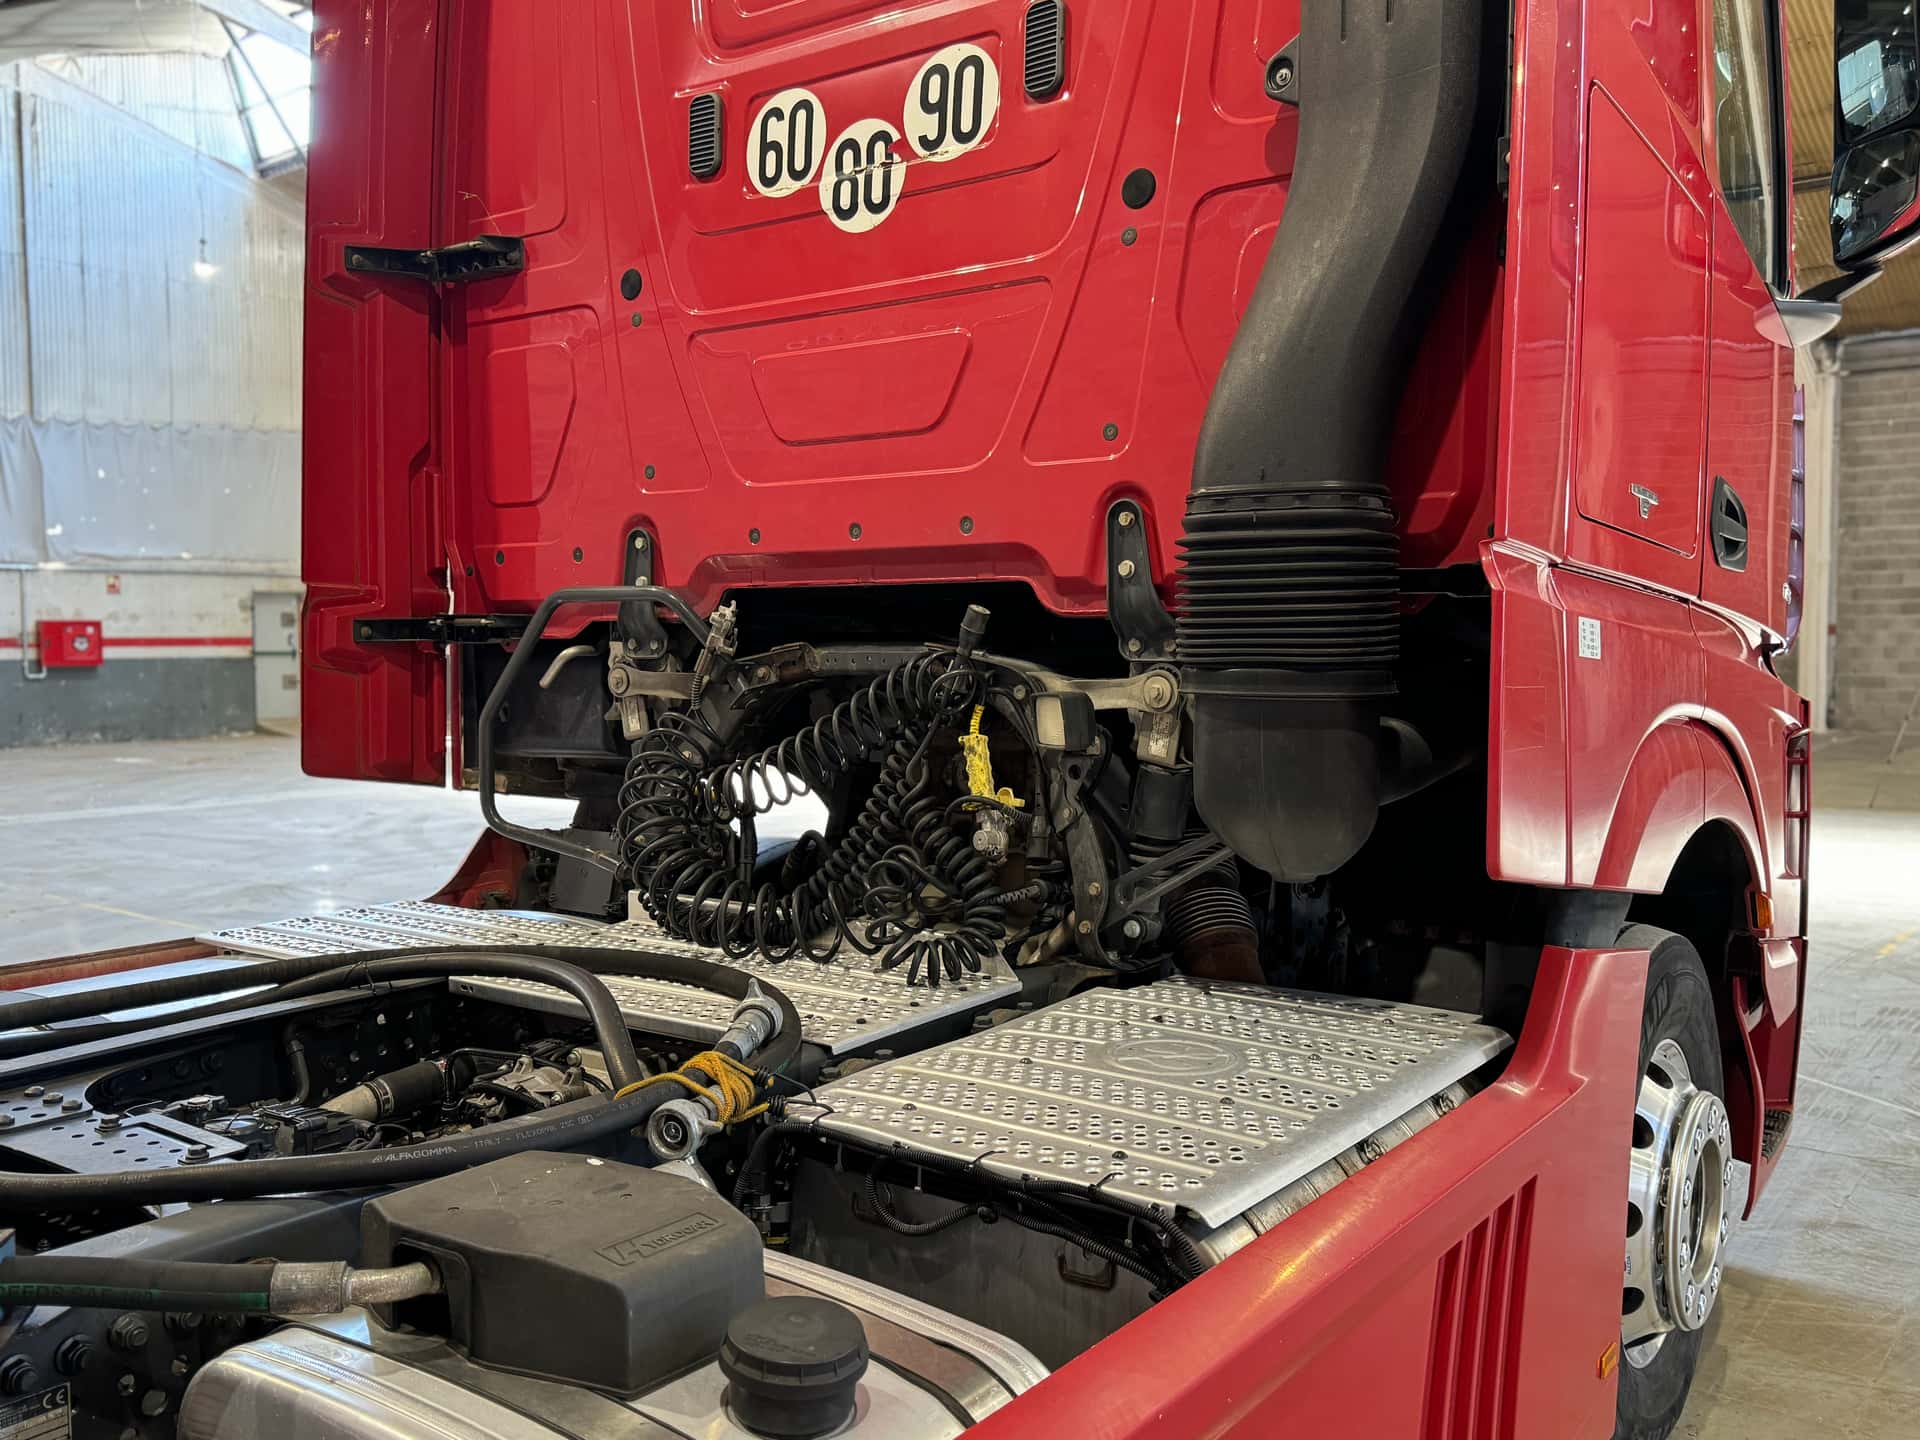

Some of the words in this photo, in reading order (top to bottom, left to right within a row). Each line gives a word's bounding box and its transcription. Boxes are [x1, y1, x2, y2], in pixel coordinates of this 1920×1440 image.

[759, 98, 815, 189] 60
[918, 55, 985, 152] 90
[832, 130, 894, 222] 80
[384, 1145, 457, 1163] ALFAGOMMA
[43, 1389, 65, 1409] CE
